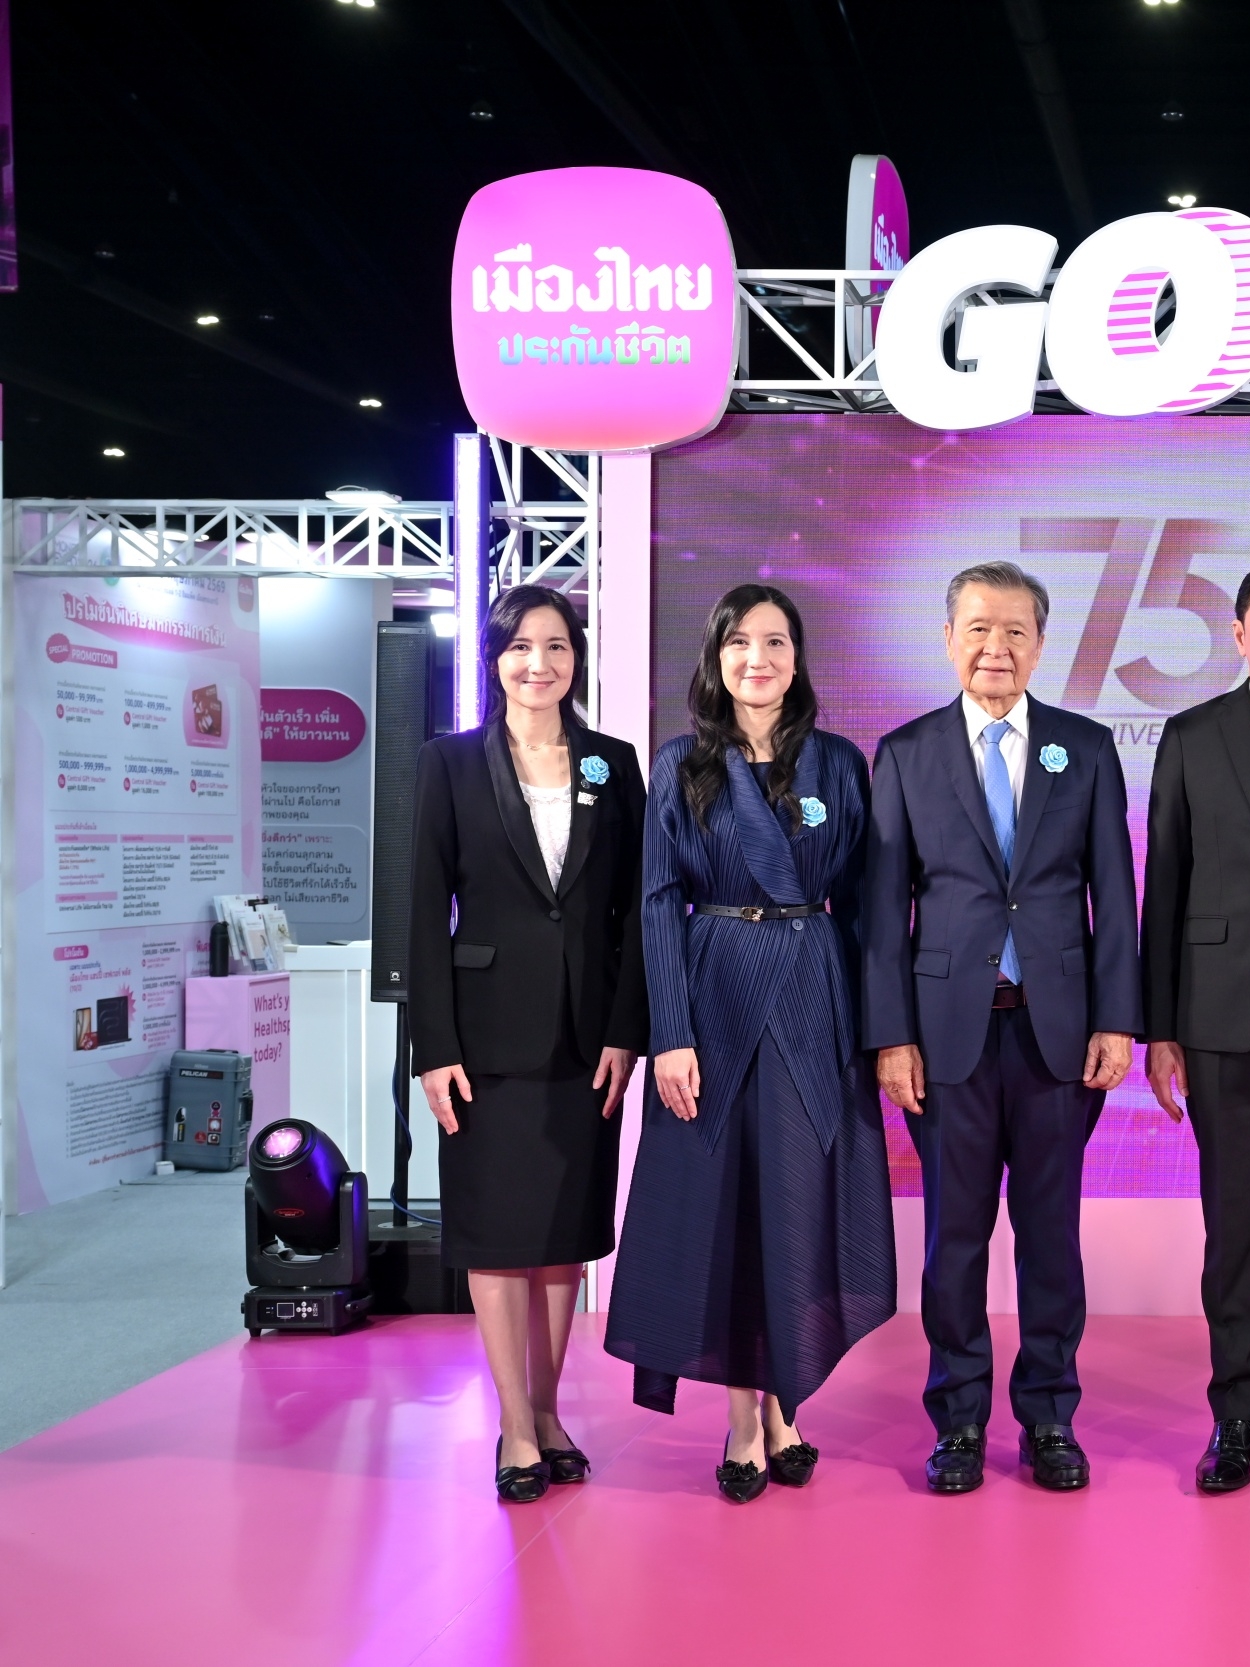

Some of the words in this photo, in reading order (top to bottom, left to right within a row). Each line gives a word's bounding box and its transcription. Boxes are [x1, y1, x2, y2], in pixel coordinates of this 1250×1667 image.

[472, 243, 713, 313] เมืองไทย
[497, 320, 691, 366] ประกันชีวิต
[48, 645, 69, 655] SPECIAL
[71, 649, 115, 665] PROMOTION
[57, 690, 75, 701] 50,000
[78, 692, 96, 703] 99,999
[124, 698, 143, 709] 100,000
[147, 701, 165, 711] 499,999
[315, 706, 340, 723] เพิ่ม
[283, 725, 350, 741] ให้ยาวนาน
[58, 760, 80, 771] 500,000
[84, 761, 104, 772] 999,999
[297, 795, 341, 807] คือโอกาส
[284, 891, 349, 903] ไม่เสียเวลาชีวิต
[254, 993, 283, 1012] What's
[254, 1042, 282, 1063] today?
[181, 1069, 208, 1077] PELICAN
